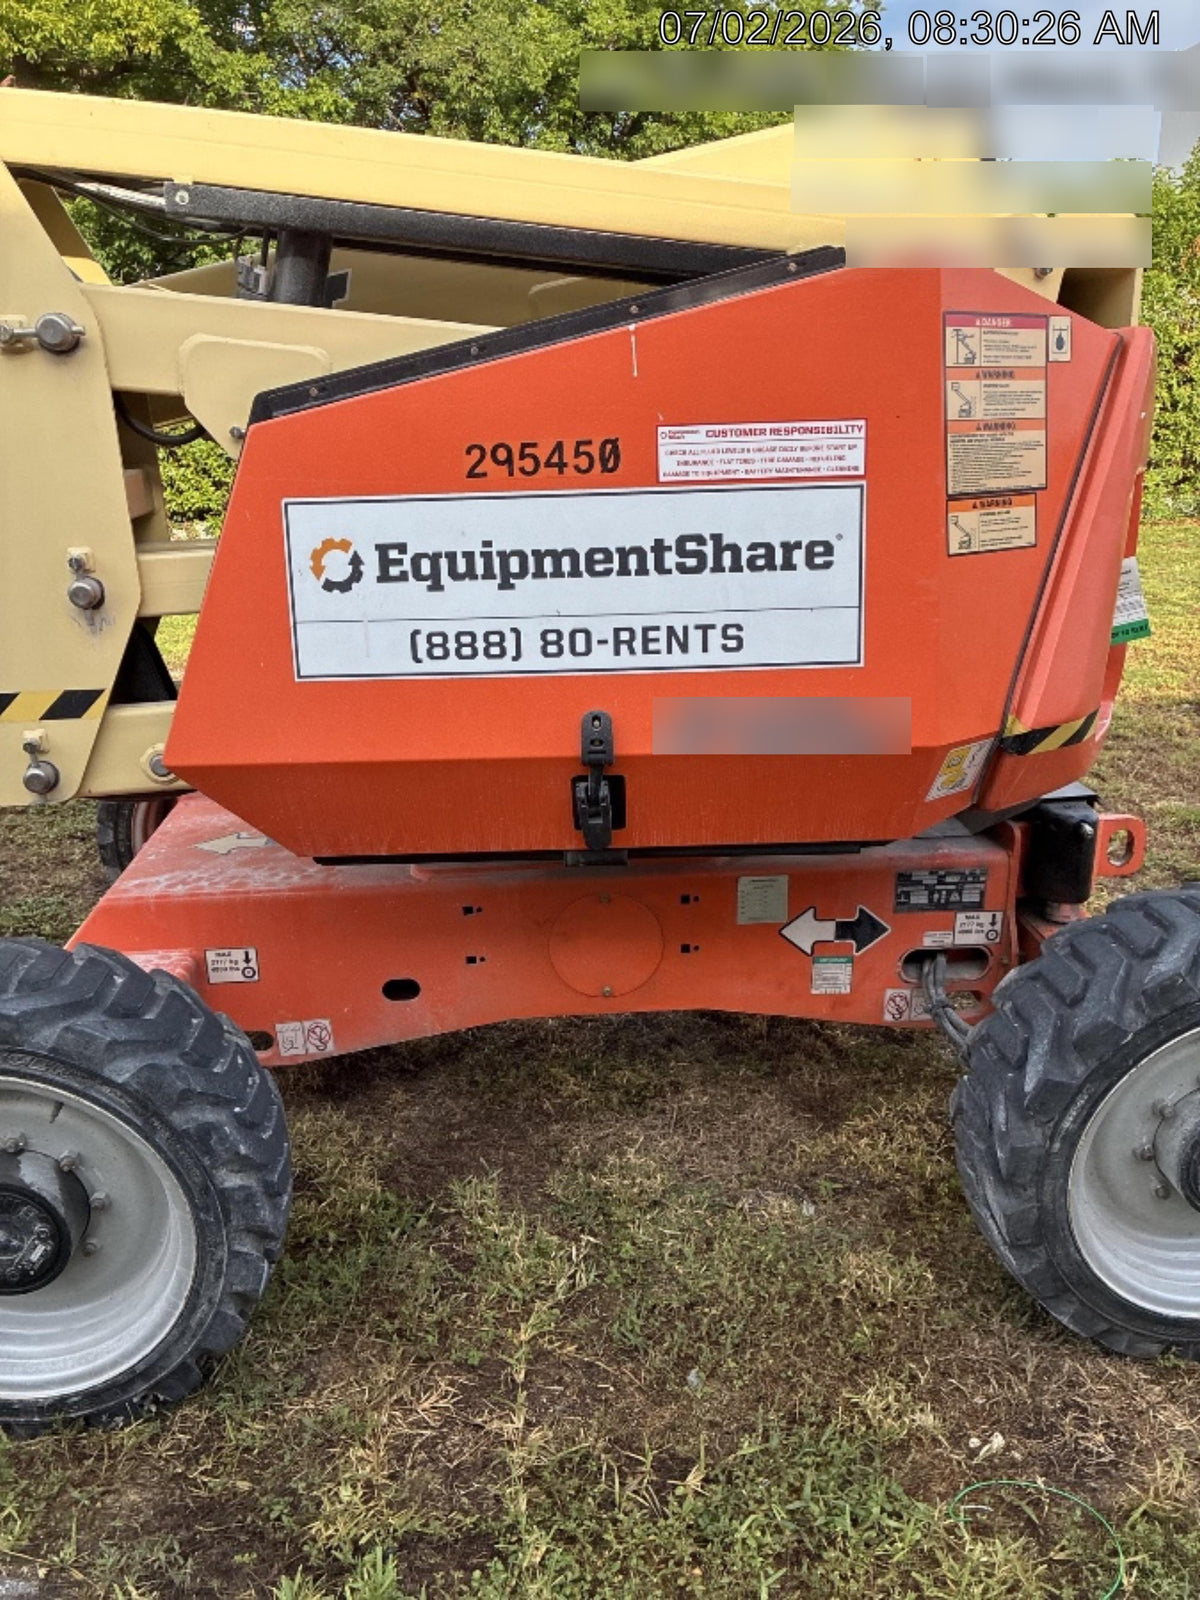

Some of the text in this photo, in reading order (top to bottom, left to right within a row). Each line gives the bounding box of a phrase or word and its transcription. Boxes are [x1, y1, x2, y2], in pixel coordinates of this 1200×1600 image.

[705, 427, 767, 438] CUSTOMER
[769, 424, 863, 436] RESPONSIBILITY
[465, 437, 621, 479] 295450
[374, 533, 835, 592] EquipmentShare
[410, 623, 744, 664] (888) 80-RENTS
